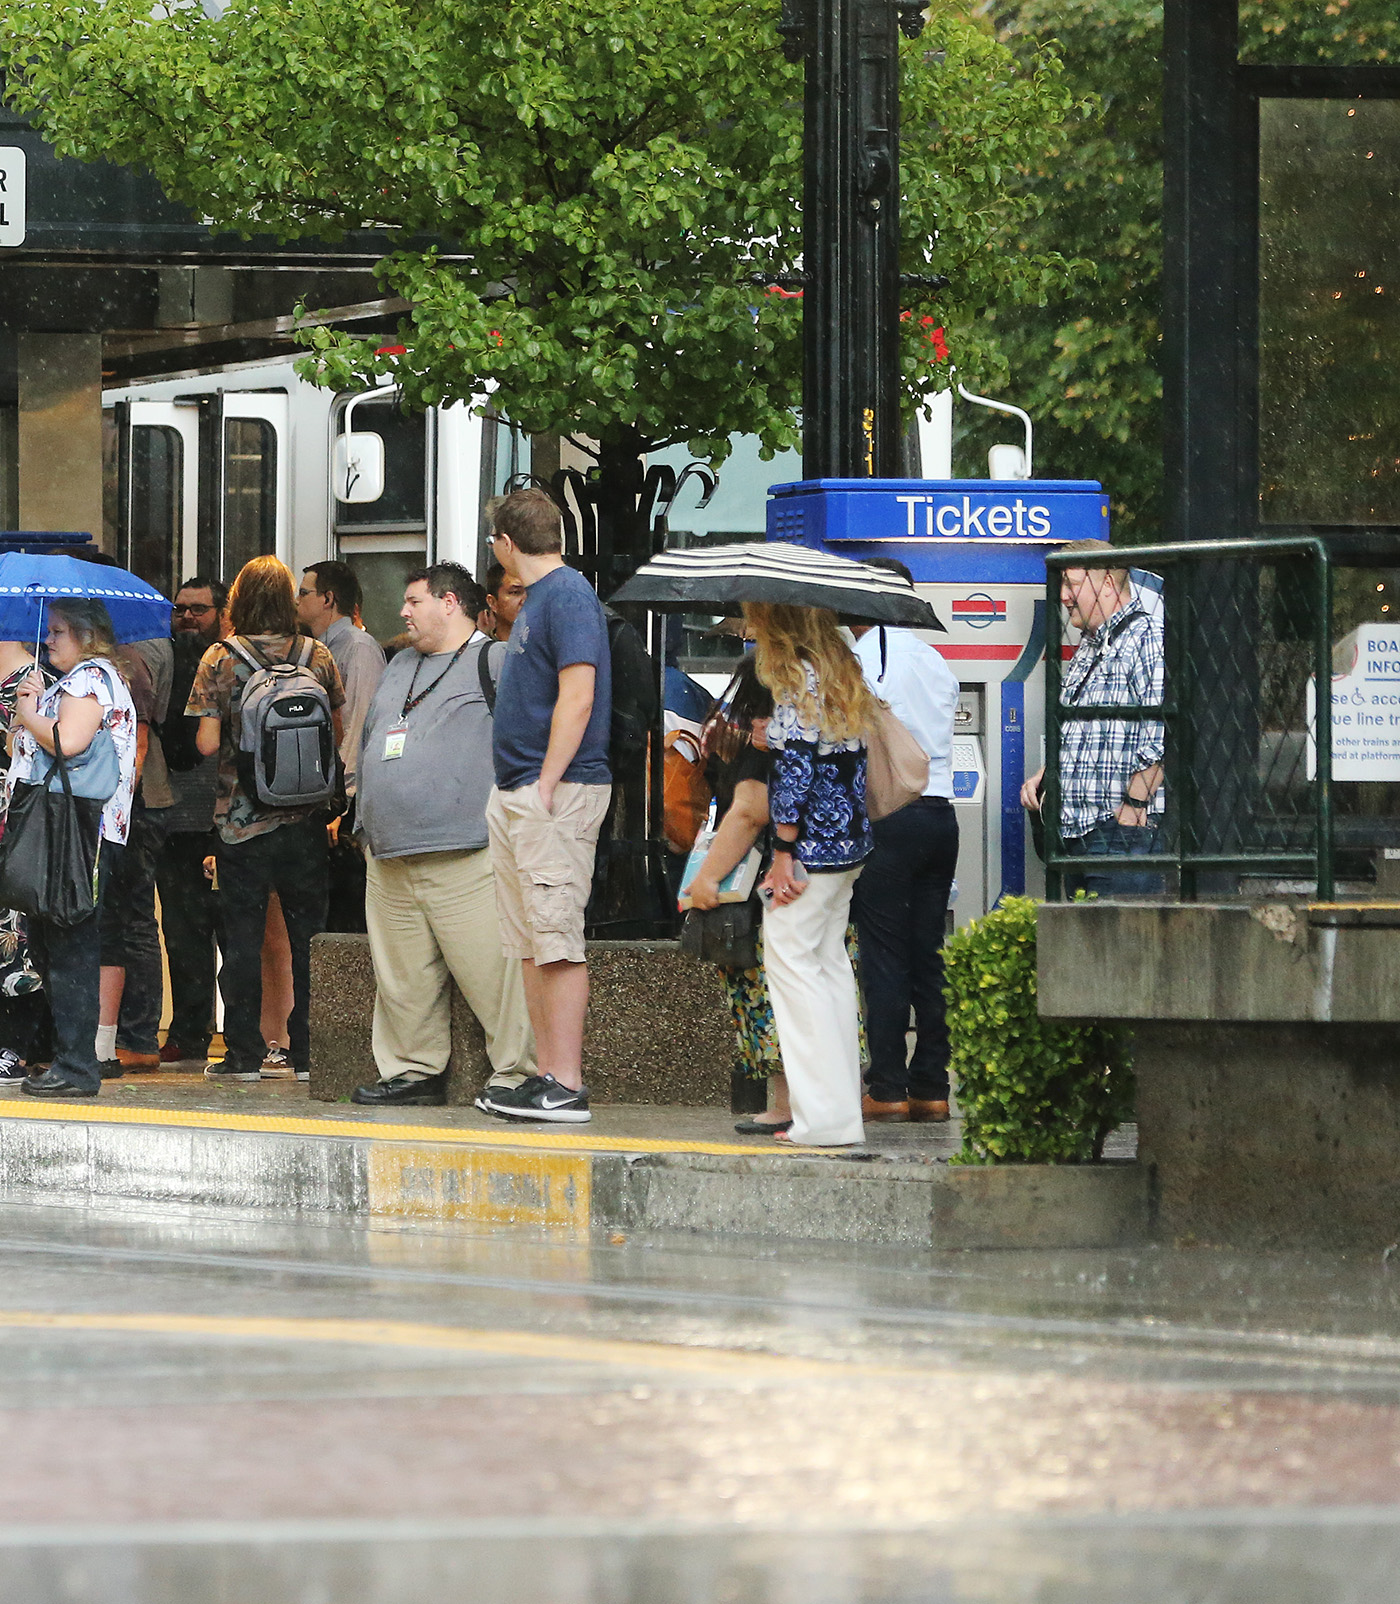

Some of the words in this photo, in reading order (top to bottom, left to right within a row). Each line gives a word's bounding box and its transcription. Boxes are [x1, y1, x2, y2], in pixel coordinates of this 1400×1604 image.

[895, 496, 1052, 537] Tickets
[1367, 639, 1400, 653] BOA
[1331, 693, 1348, 705] se
[1371, 693, 1400, 706] acc
[1332, 715, 1351, 726] ue
[1357, 712, 1384, 726] line
[1336, 737, 1361, 747] other
[1363, 737, 1390, 747] trains
[1350, 751, 1359, 760] at
